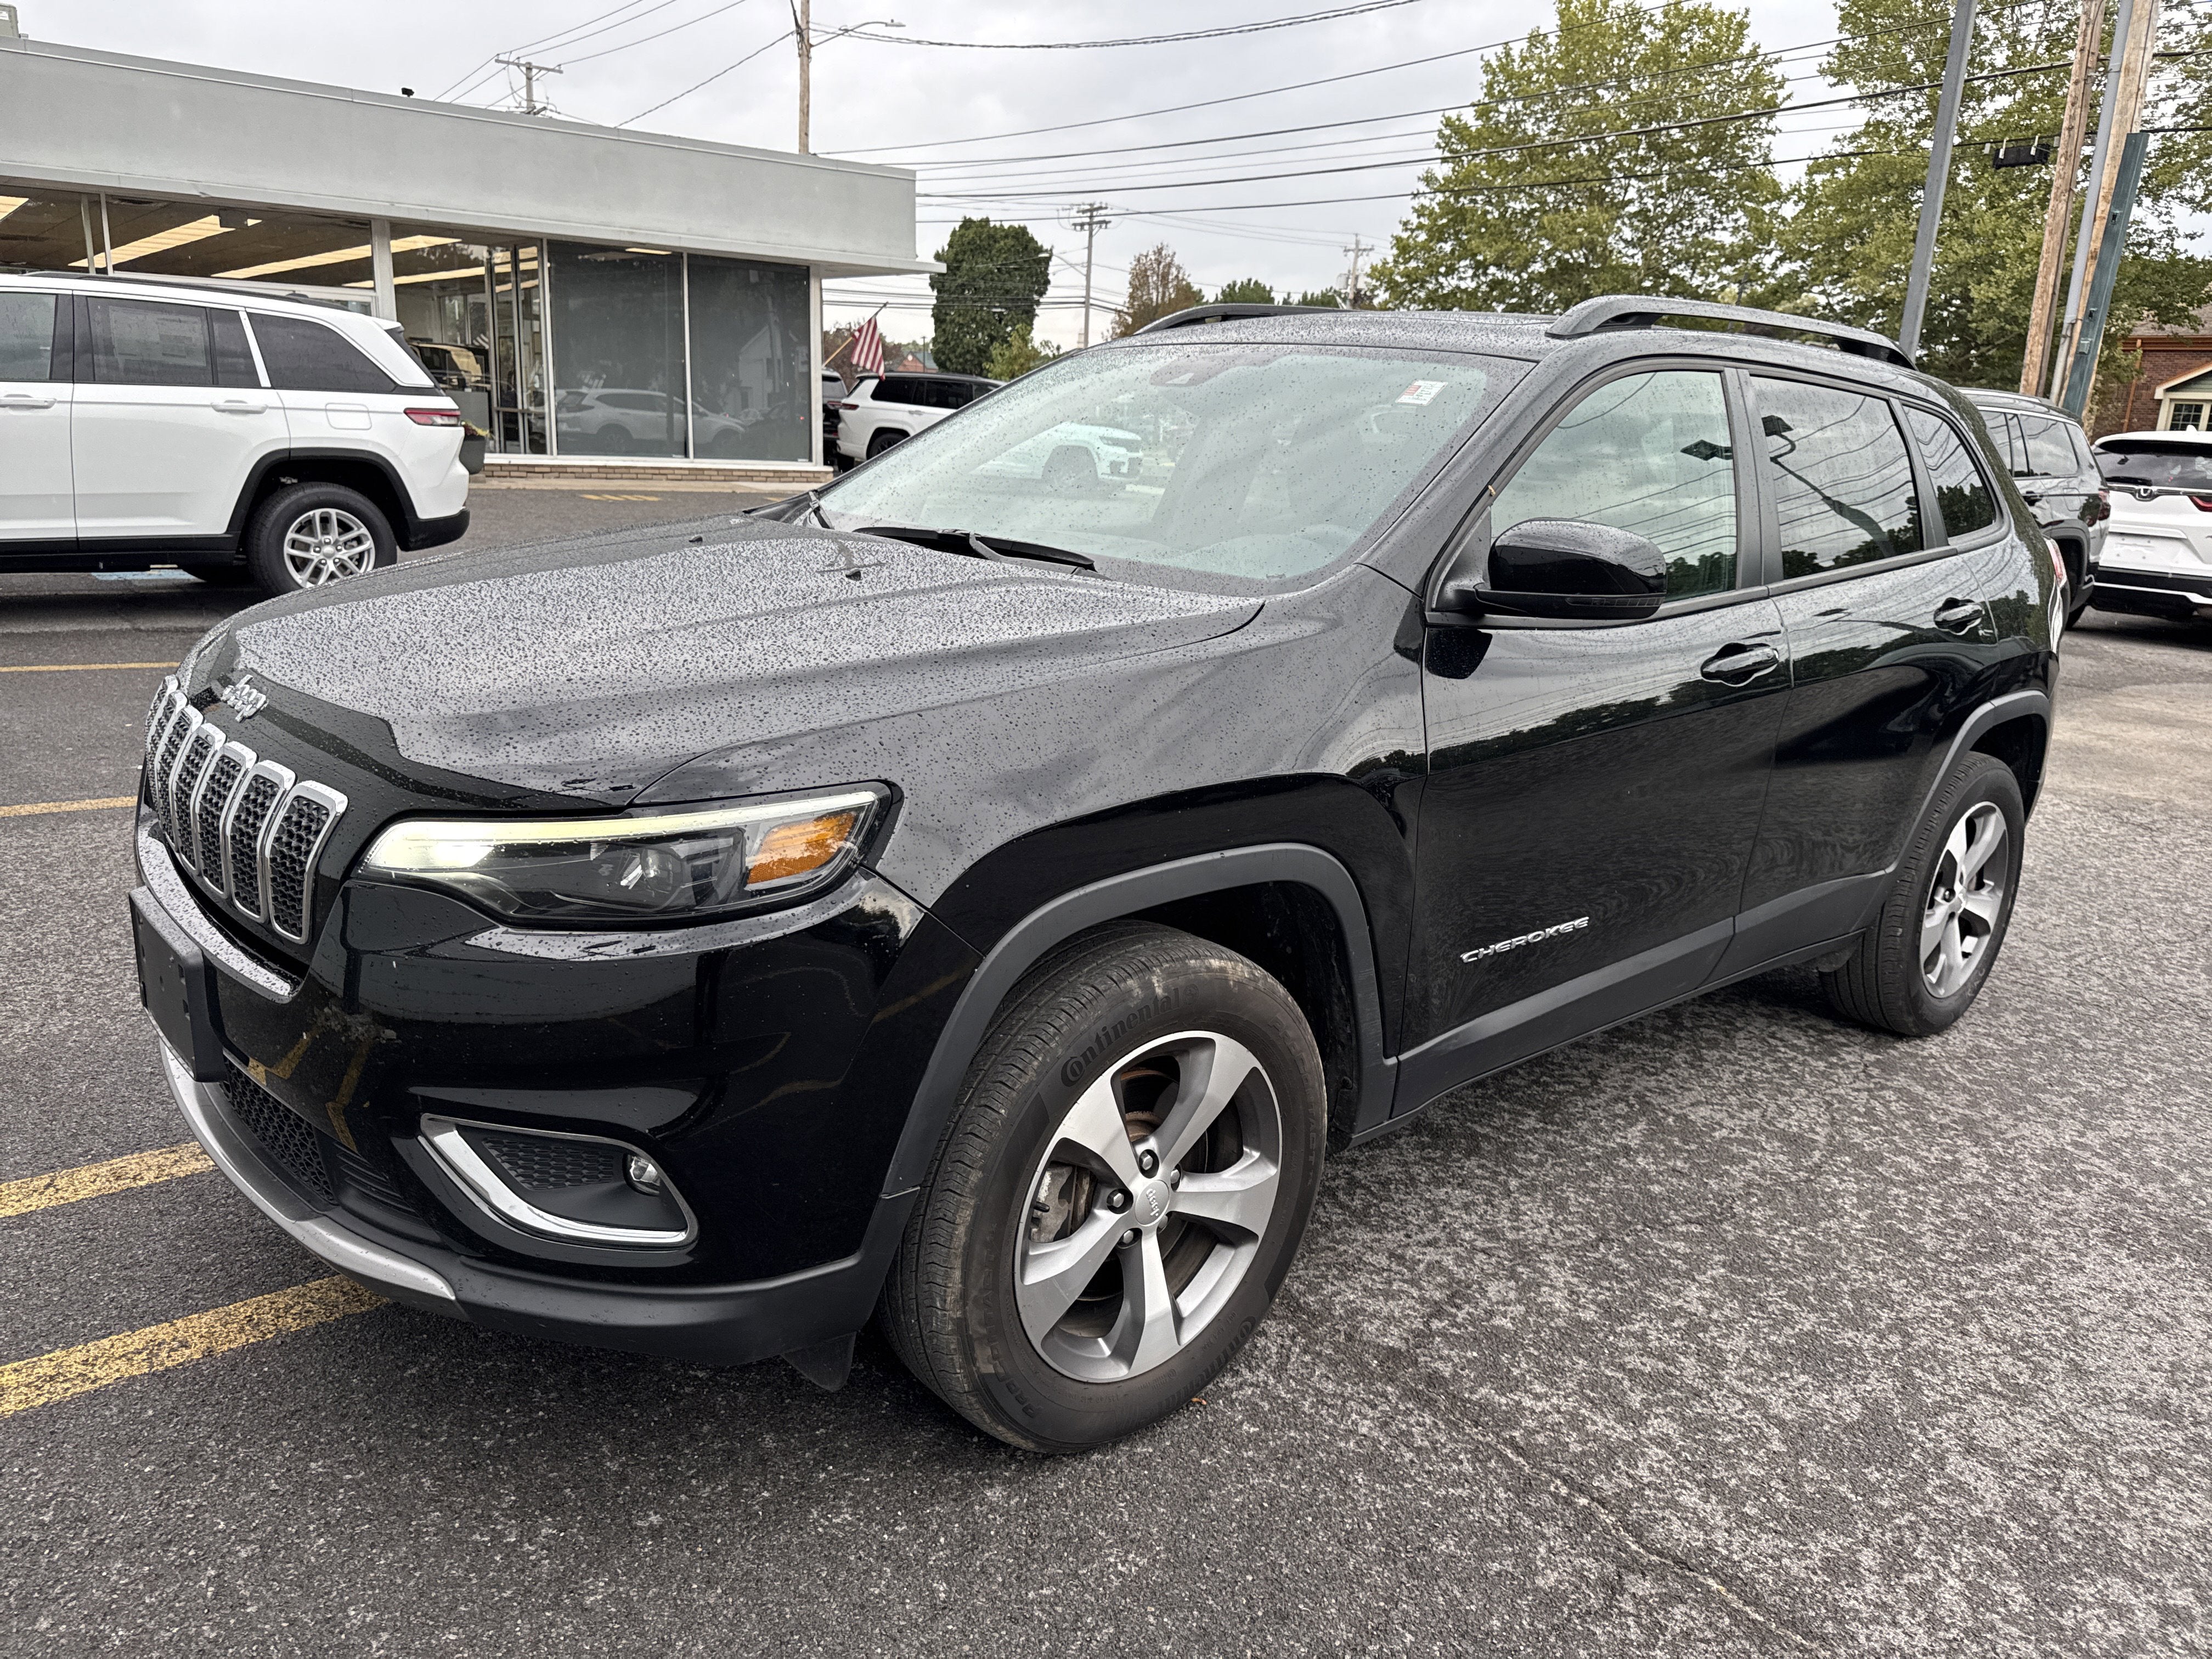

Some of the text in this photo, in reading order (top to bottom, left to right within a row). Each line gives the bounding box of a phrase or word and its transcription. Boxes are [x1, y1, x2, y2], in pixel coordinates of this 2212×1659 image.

[219, 674, 268, 723] Jeep
[1460, 916, 1589, 963] CHEROKEE
[1060, 988, 1180, 1087] Continental
[1146, 1188, 1160, 1217] Jeep
